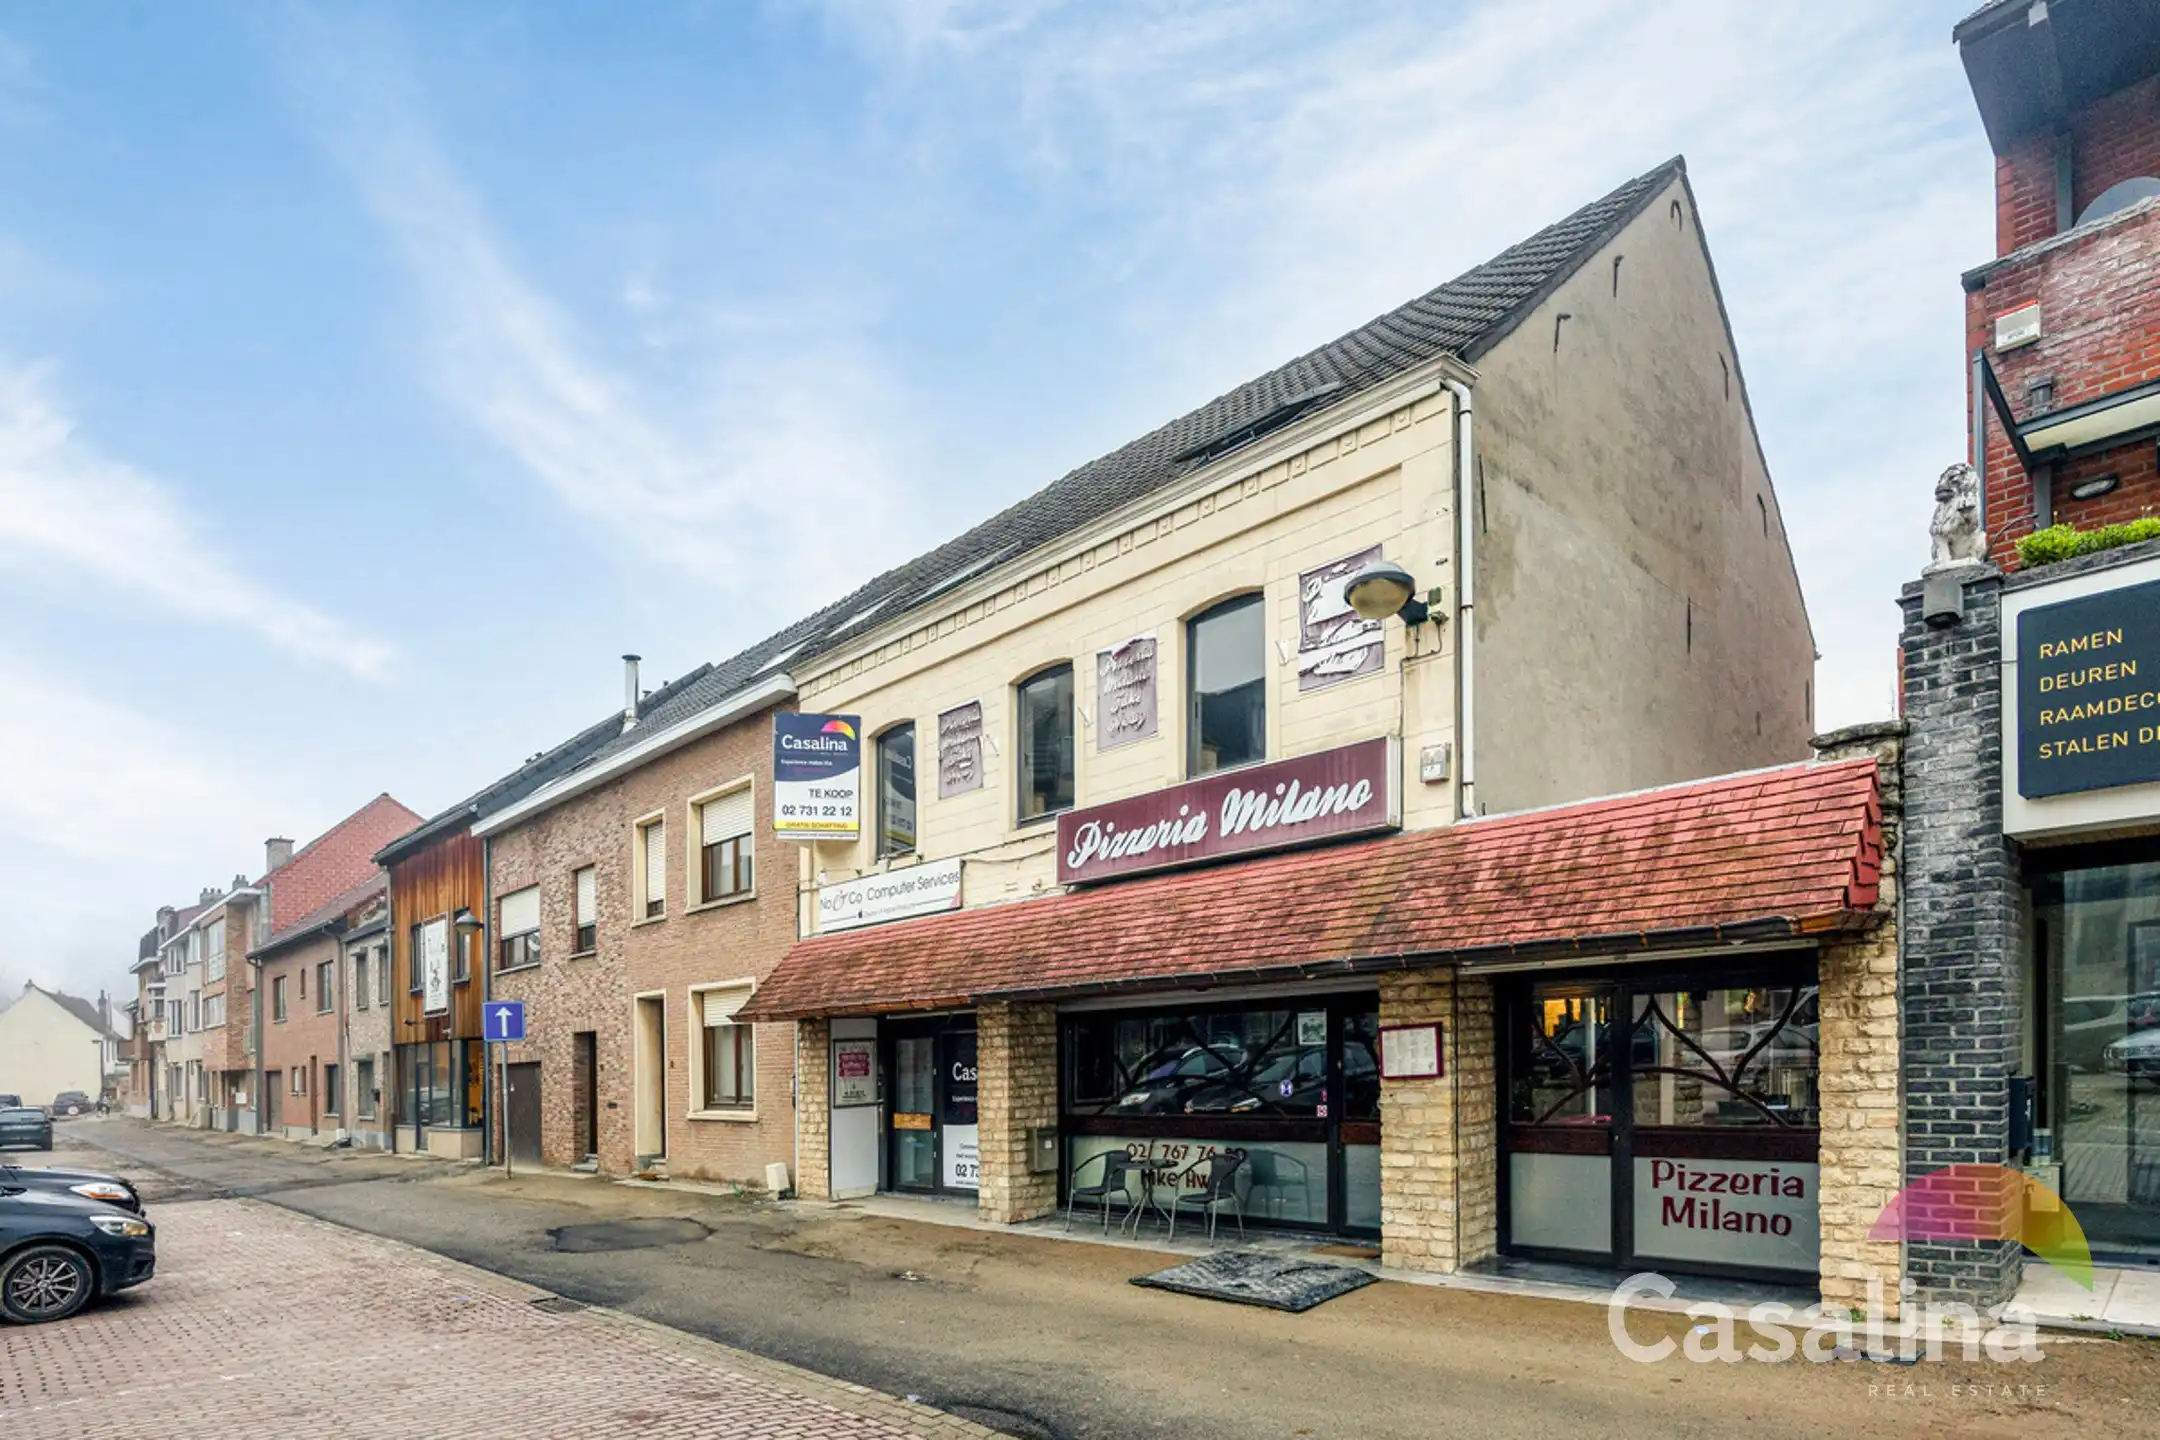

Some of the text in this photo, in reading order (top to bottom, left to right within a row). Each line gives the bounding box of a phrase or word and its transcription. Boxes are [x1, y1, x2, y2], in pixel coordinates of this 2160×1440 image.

[2039, 628, 2124, 660] RAMEN
[2039, 660, 2137, 693] DEUREN
[2039, 691, 2160, 726] RAAMDEC
[781, 733, 849, 752] Casalina
[2039, 731, 2129, 760] STALEN
[808, 788, 854, 800] TE KOOP
[782, 804, 853, 817] 02 731 22 12
[1066, 778, 1373, 869] Pizzeria Milano
[867, 880, 916, 901] Computer
[917, 871, 961, 891] Services
[1161, 1144, 1189, 1160] 767
[955, 1163, 968, 1178] 02
[1651, 1159, 1805, 1199] Pizzeria
[1661, 1195, 1793, 1237] Milano
